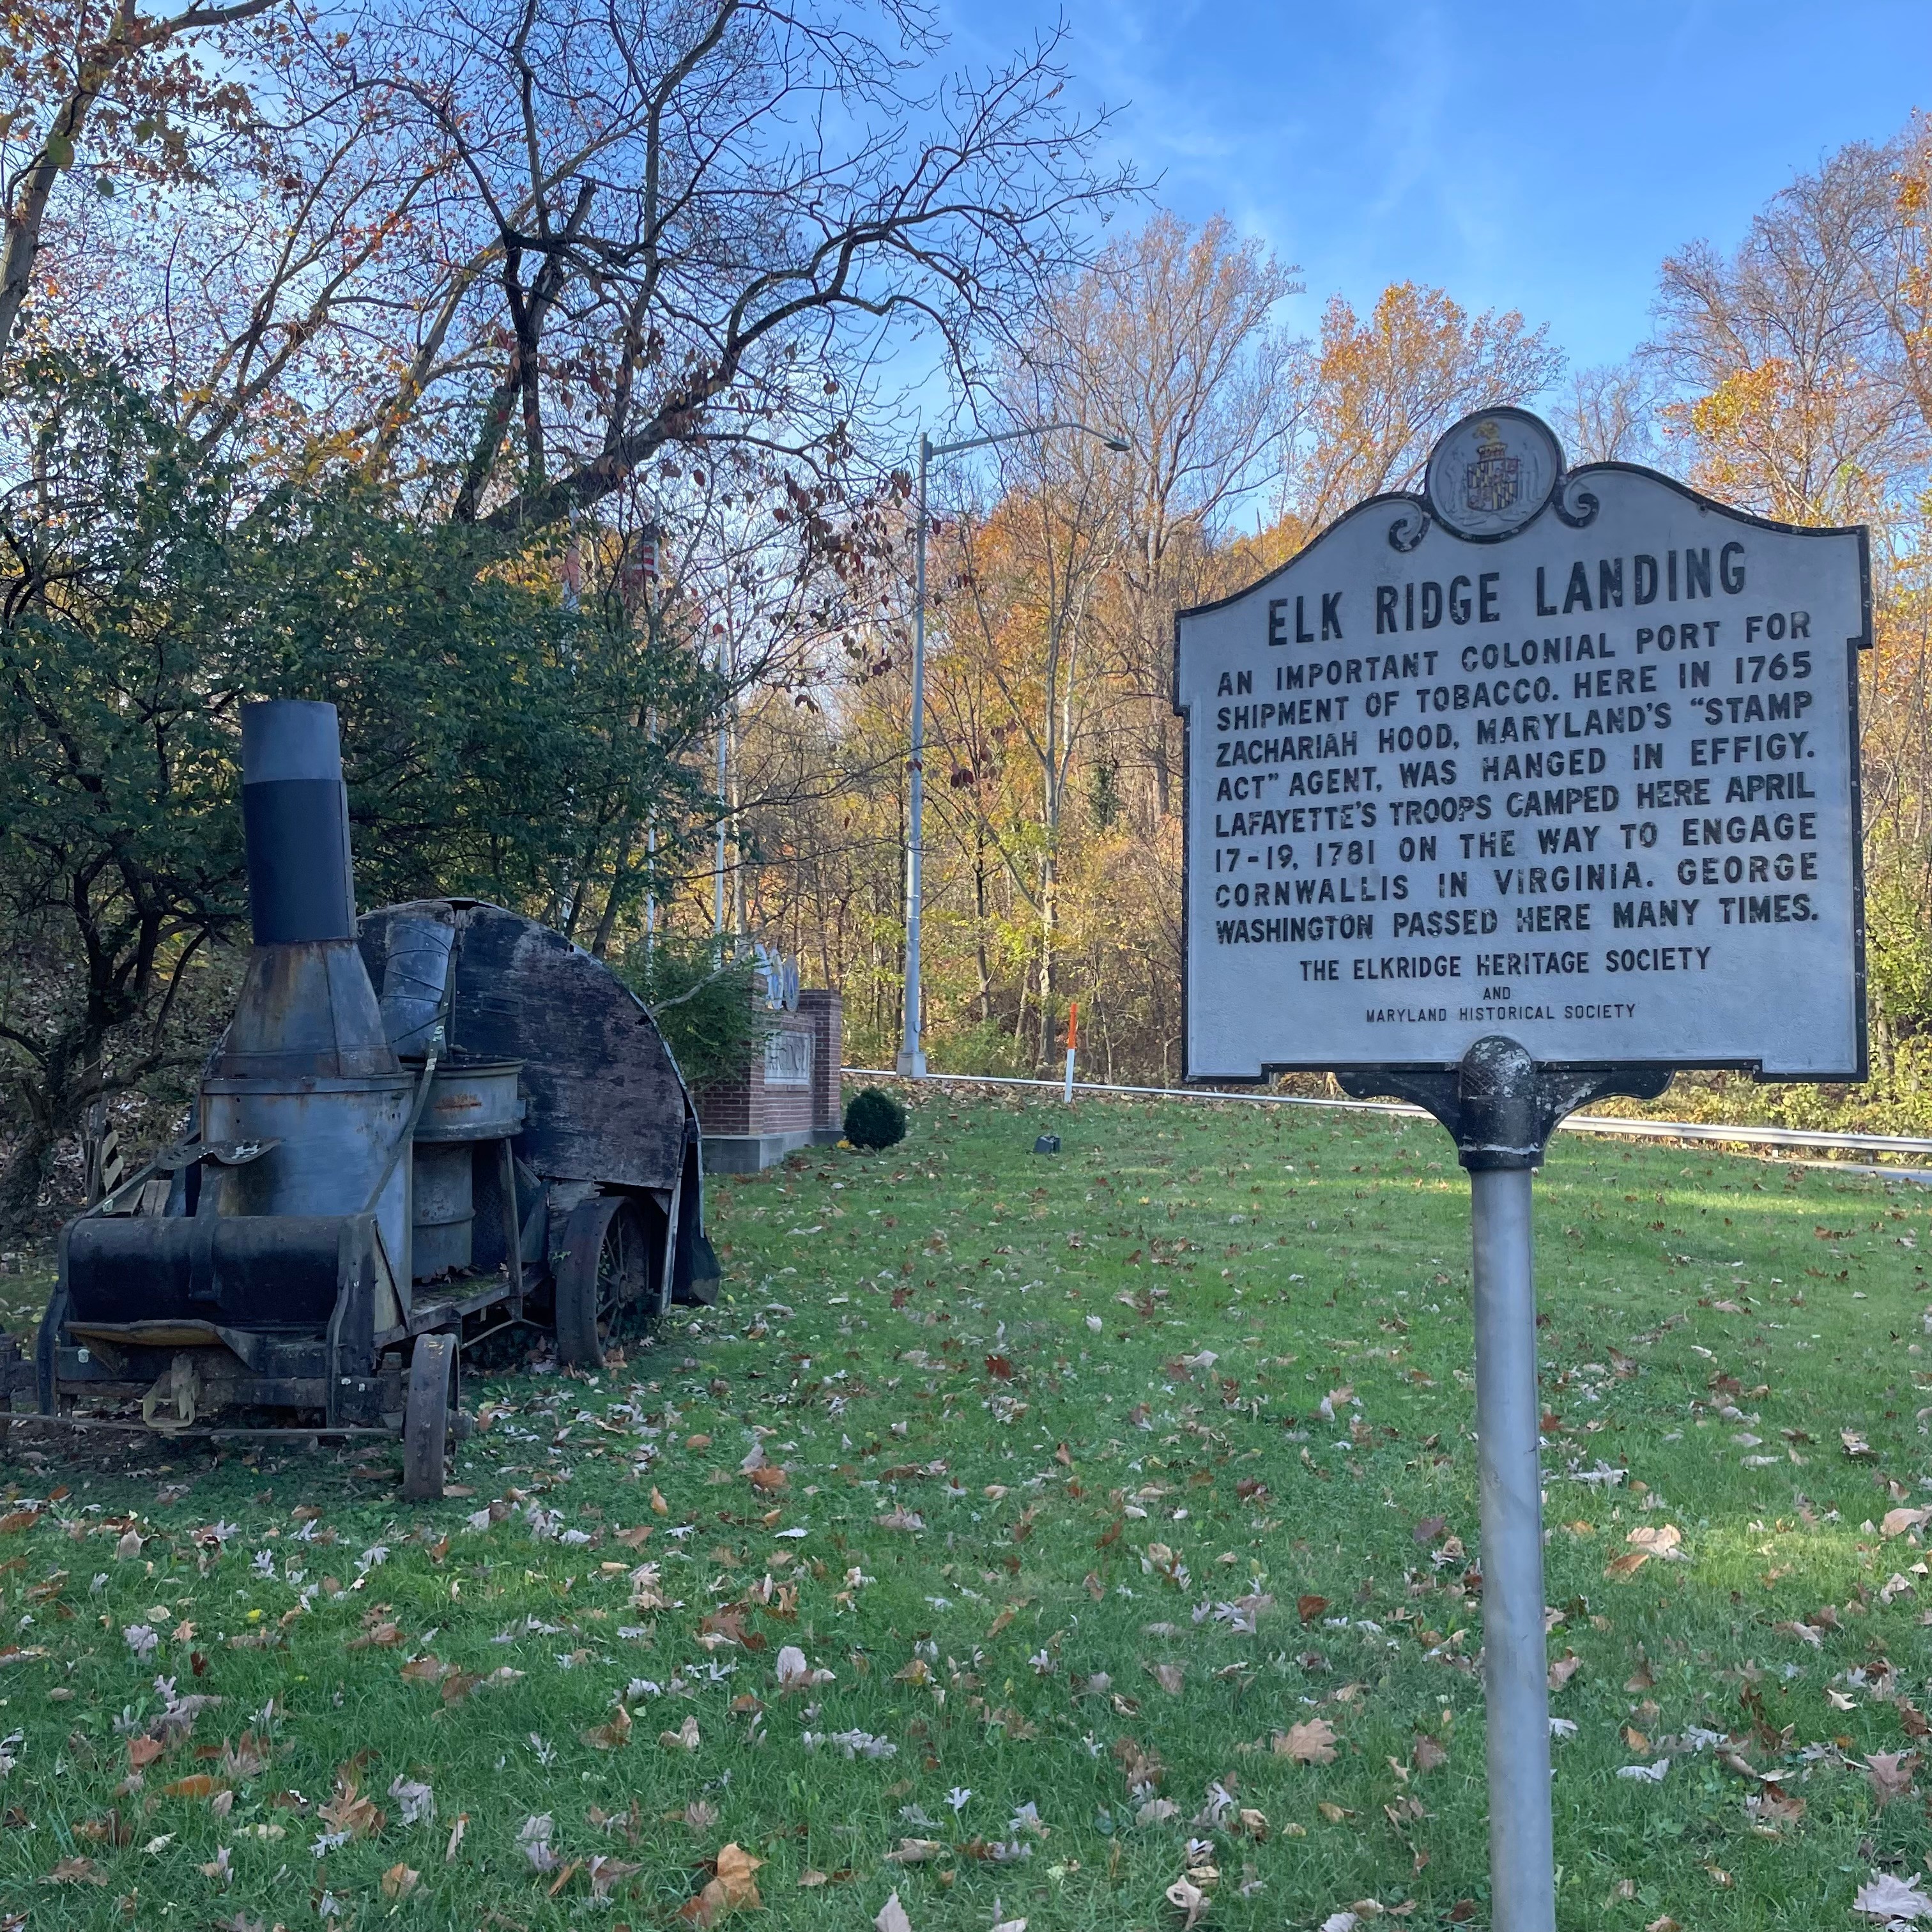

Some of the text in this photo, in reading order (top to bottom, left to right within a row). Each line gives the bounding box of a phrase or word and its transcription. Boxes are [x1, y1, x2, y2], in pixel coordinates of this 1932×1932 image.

[1268, 541, 1745, 647] ELK RIDGE LANDING
[1217, 611, 1811, 697] AN IMPORTANT COLONIAL PORT FOR
[1216, 650, 1812, 732] SHIPMENT OF TOBACCO. HERE IN 1765
[1216, 730, 1358, 768] ZACHARIAH
[1379, 723, 1460, 753] HOOD,
[1289, 766, 1383, 797] AGENT,
[1399, 759, 1457, 789] WAS
[1482, 747, 1606, 782] HANGED
[1633, 742, 1663, 770] IN
[1690, 730, 1814, 767] EFFIGY.
[1389, 793, 1492, 827] TROOPS
[1506, 785, 1620, 818] CAMPED
[1636, 778, 1711, 809] HERE
[1725, 771, 1816, 804] APRIL
[1216, 811, 1818, 873] 17-19, 1781 ON THE WAY TO ENGAGE
[1215, 852, 1818, 908] CORNWALLIS IN VIRGINIA. GEORGE
[1216, 893, 1820, 945] WASHINGTON PASSED HERE MANY TIMES.
[1299, 946, 1712, 981] THE ELKRIDGE HERITAGE SOCIETY
[1366, 1003, 1636, 1023] MARYLAND HISTORICAL SOCIETY
[1482, 986, 1511, 1000] AND
